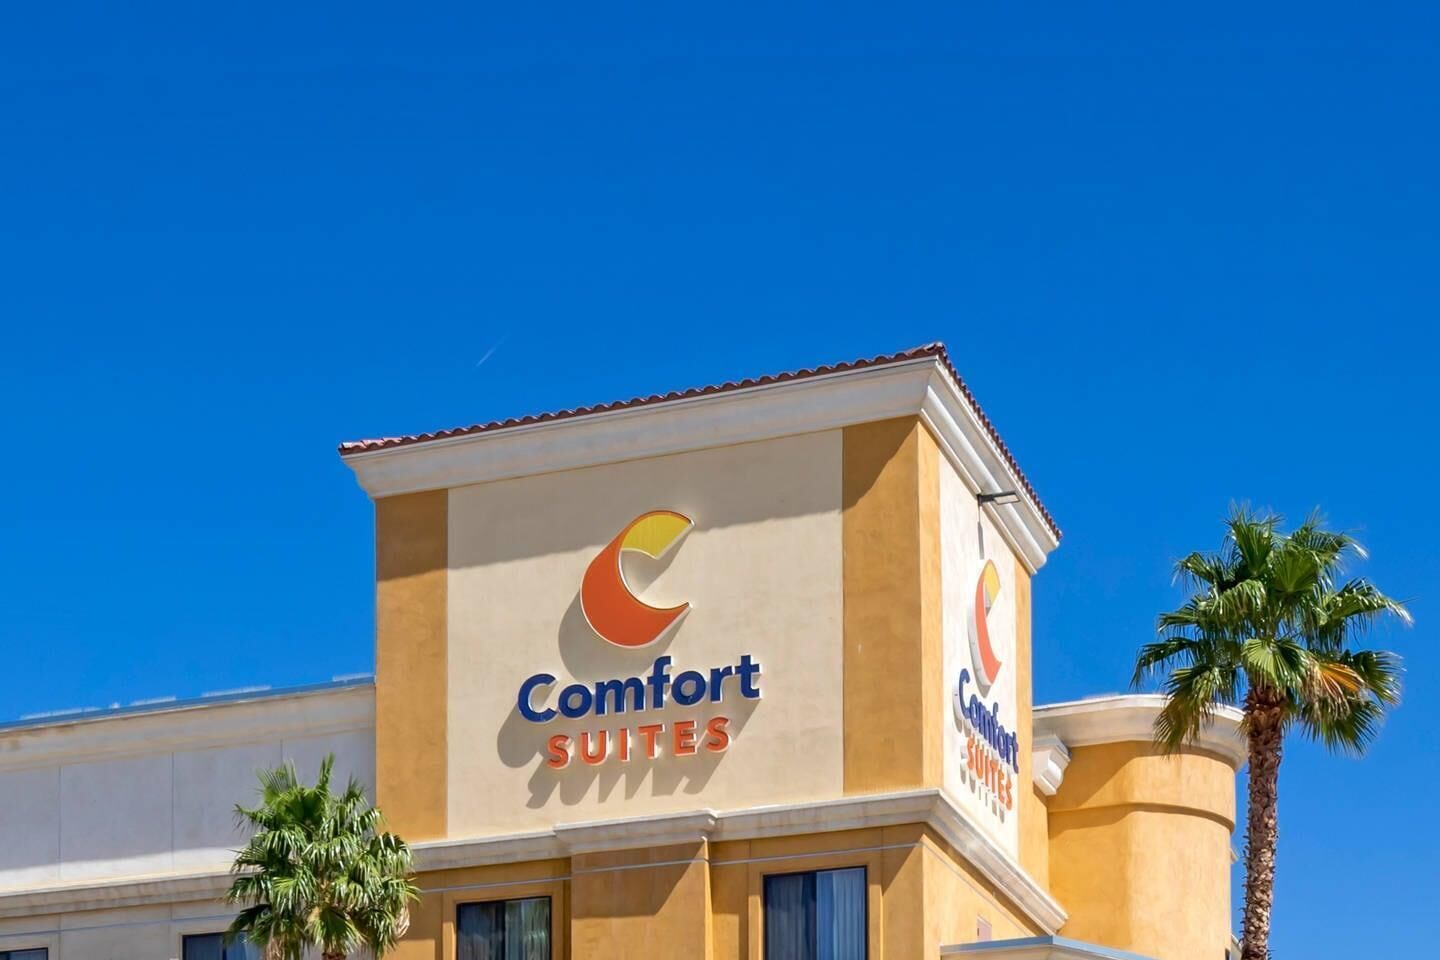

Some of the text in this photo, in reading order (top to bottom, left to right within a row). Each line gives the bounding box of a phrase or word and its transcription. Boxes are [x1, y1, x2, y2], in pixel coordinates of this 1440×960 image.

[518, 655, 760, 723] Comfort
[959, 668, 1018, 774] Comfort
[547, 717, 729, 769] SUITES
[967, 736, 1012, 810] SUITES
